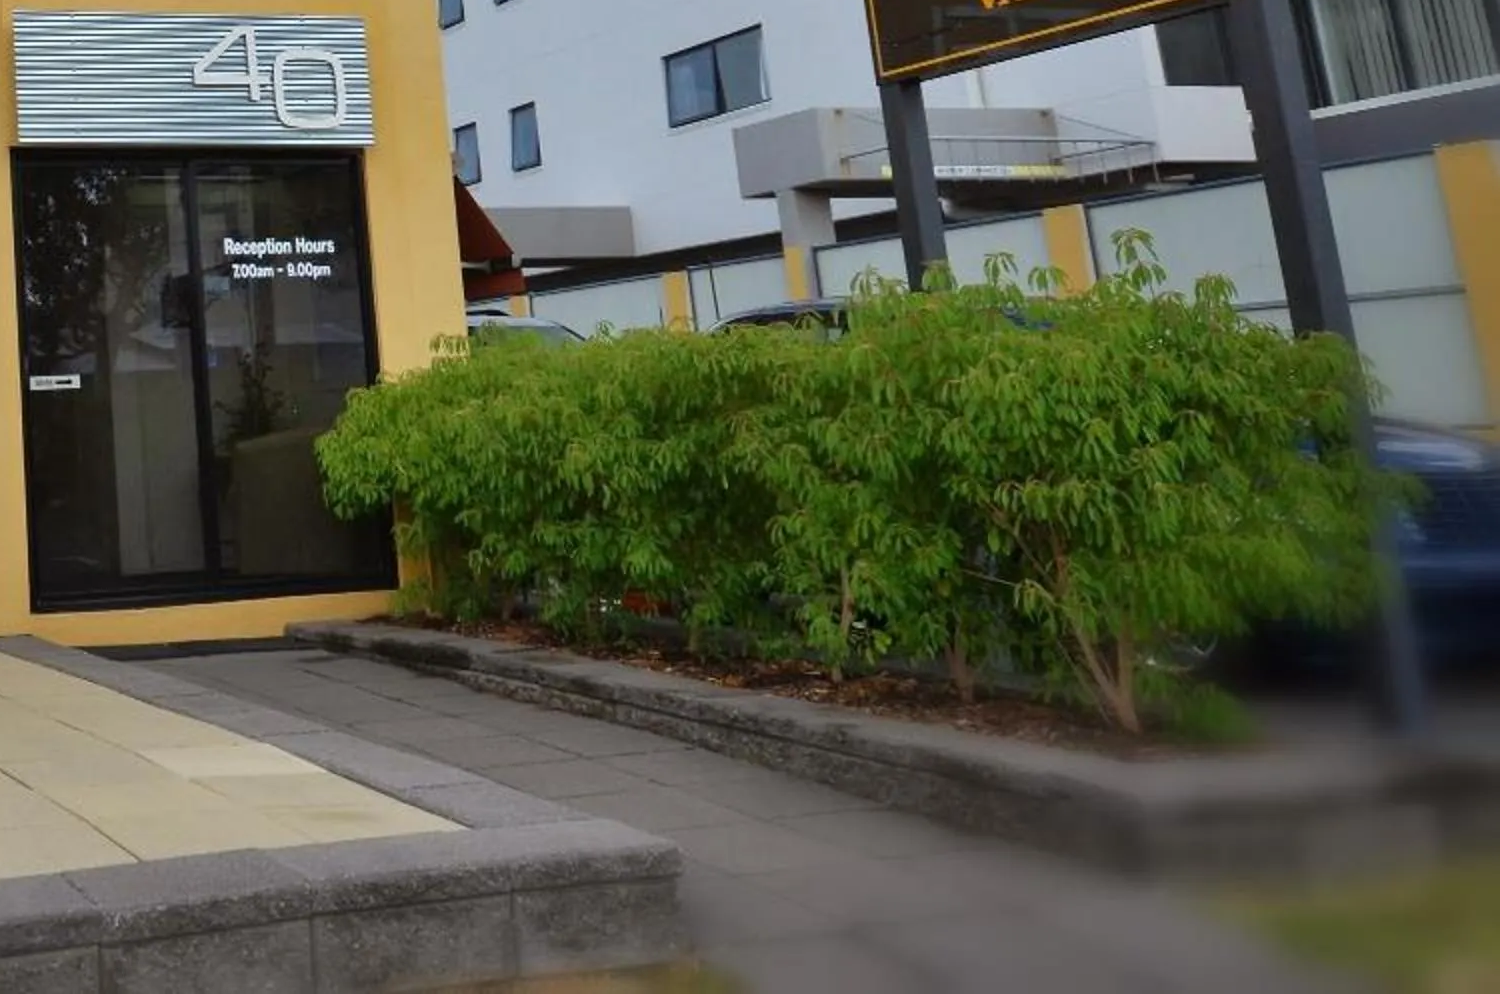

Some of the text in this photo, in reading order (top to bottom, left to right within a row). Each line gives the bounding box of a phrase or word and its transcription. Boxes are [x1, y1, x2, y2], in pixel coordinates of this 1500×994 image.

[191, 25, 347, 129] 40
[223, 235, 336, 259] Reception Hours
[287, 262, 331, 281] 9.00pm
